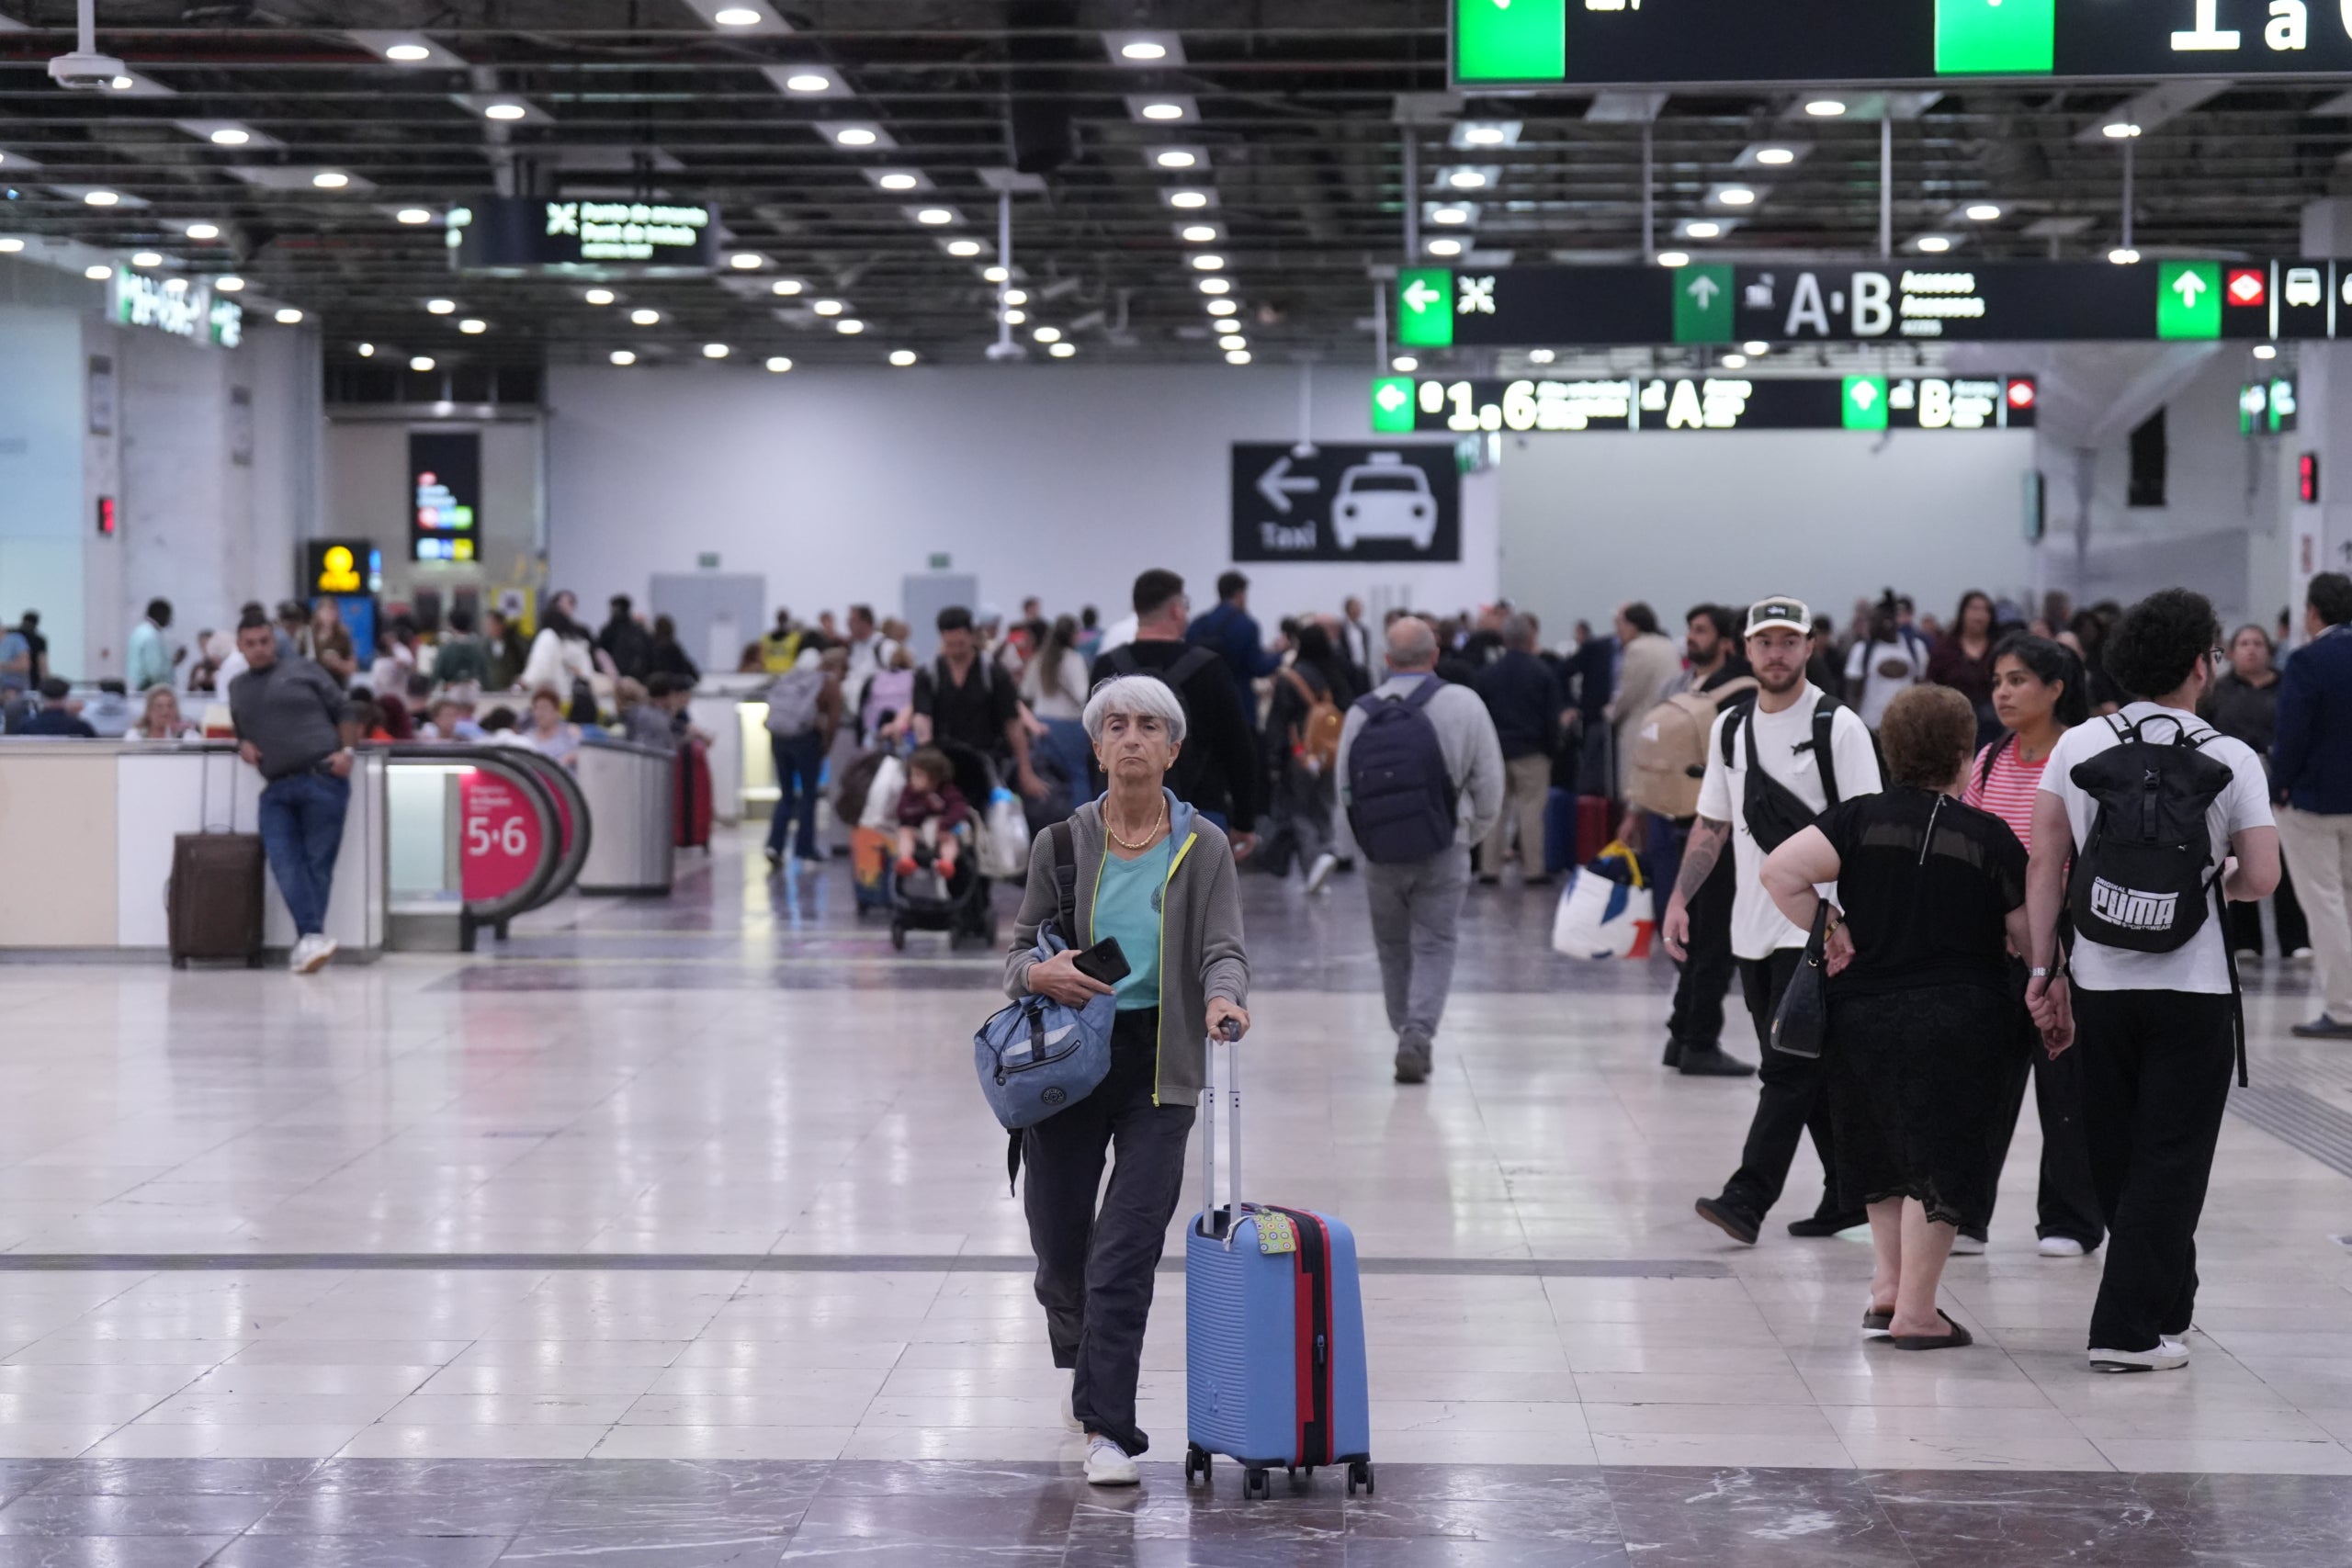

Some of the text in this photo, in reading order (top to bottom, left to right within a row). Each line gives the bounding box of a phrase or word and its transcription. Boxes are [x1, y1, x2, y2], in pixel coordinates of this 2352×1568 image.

[1259, 521, 1317, 549] Taxi
[2095, 875, 2127, 894] ORIGINAL
[2091, 881, 2177, 926] PUMA
